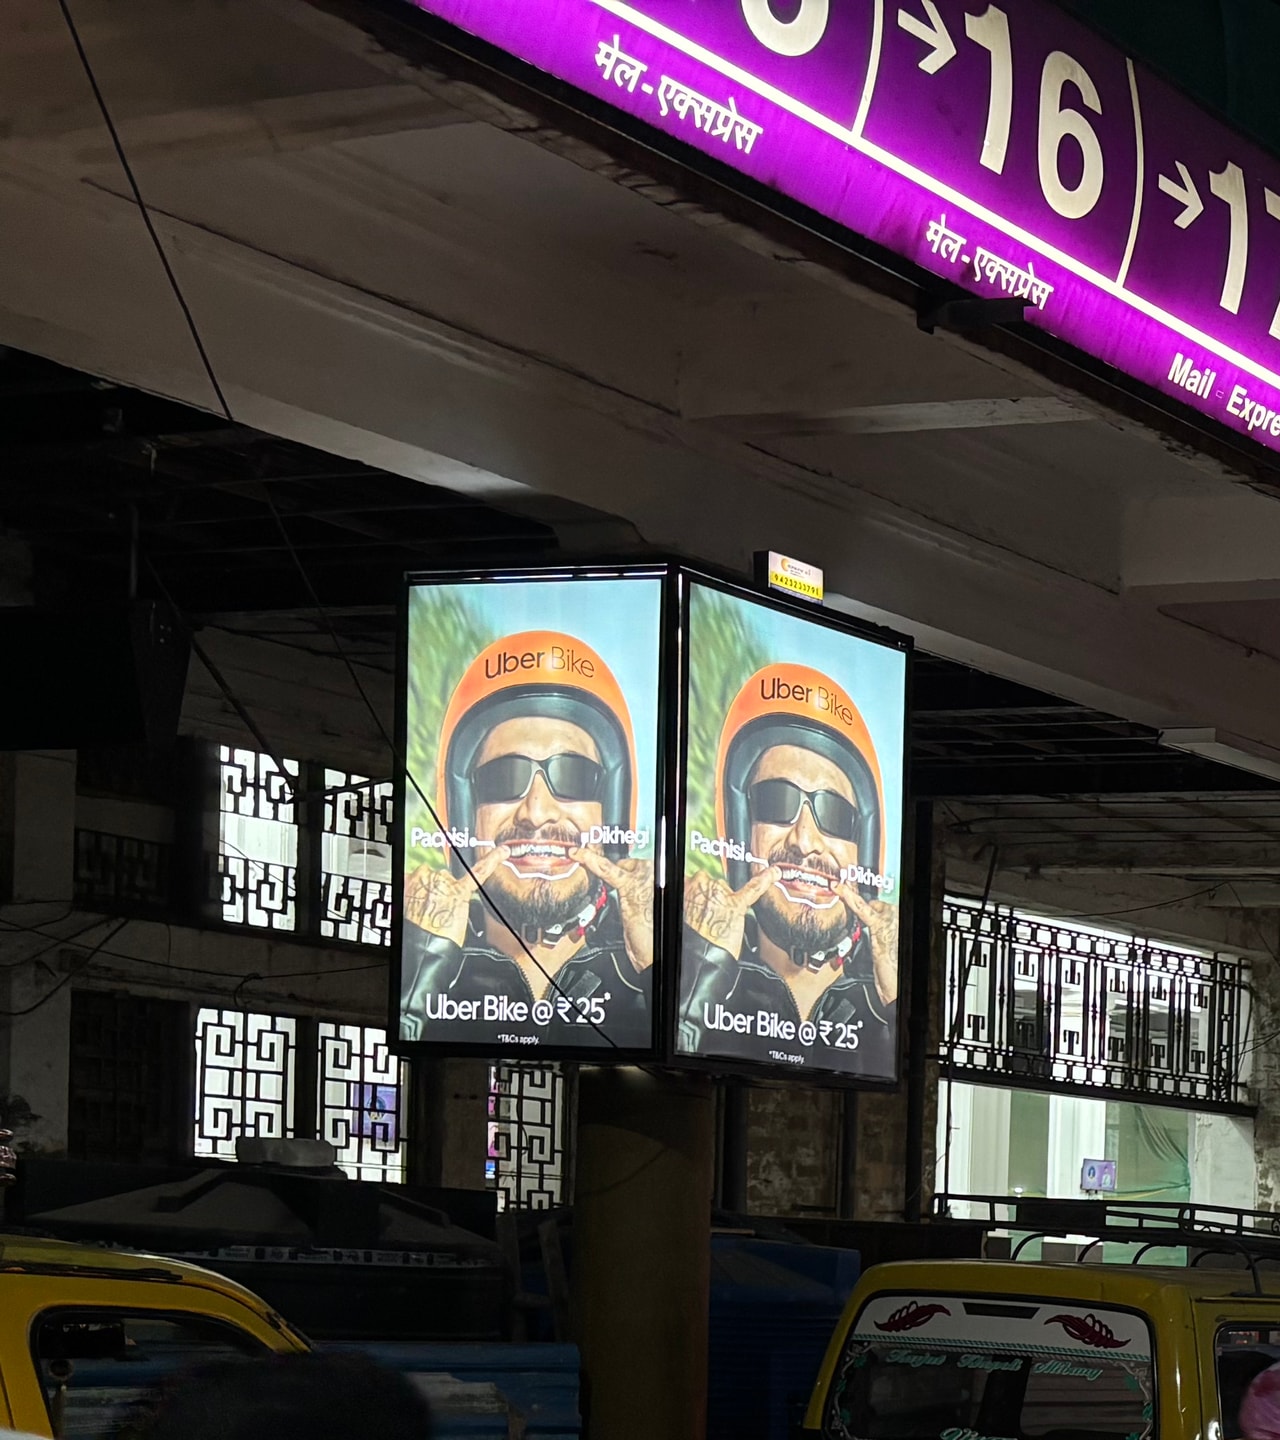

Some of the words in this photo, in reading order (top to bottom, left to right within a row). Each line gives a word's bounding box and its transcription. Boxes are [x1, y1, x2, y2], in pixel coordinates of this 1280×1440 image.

[964, 3, 1104, 219] 16
[1167, 352, 1217, 399] Mail
[485, 651, 545, 679] Uber
[551, 646, 595, 678] Bike
[761, 678, 813, 703] Uber
[818, 686, 853, 726] Bike
[590, 825, 649, 849] Dikhegi
[690, 830, 745, 861] Pachisi
[848, 865, 894, 893] Dikhegi
[425, 993, 480, 1020] Uber
[484, 995, 528, 1022] Bike
[703, 1002, 754, 1034] Uber
[757, 1011, 795, 1040] Bike
